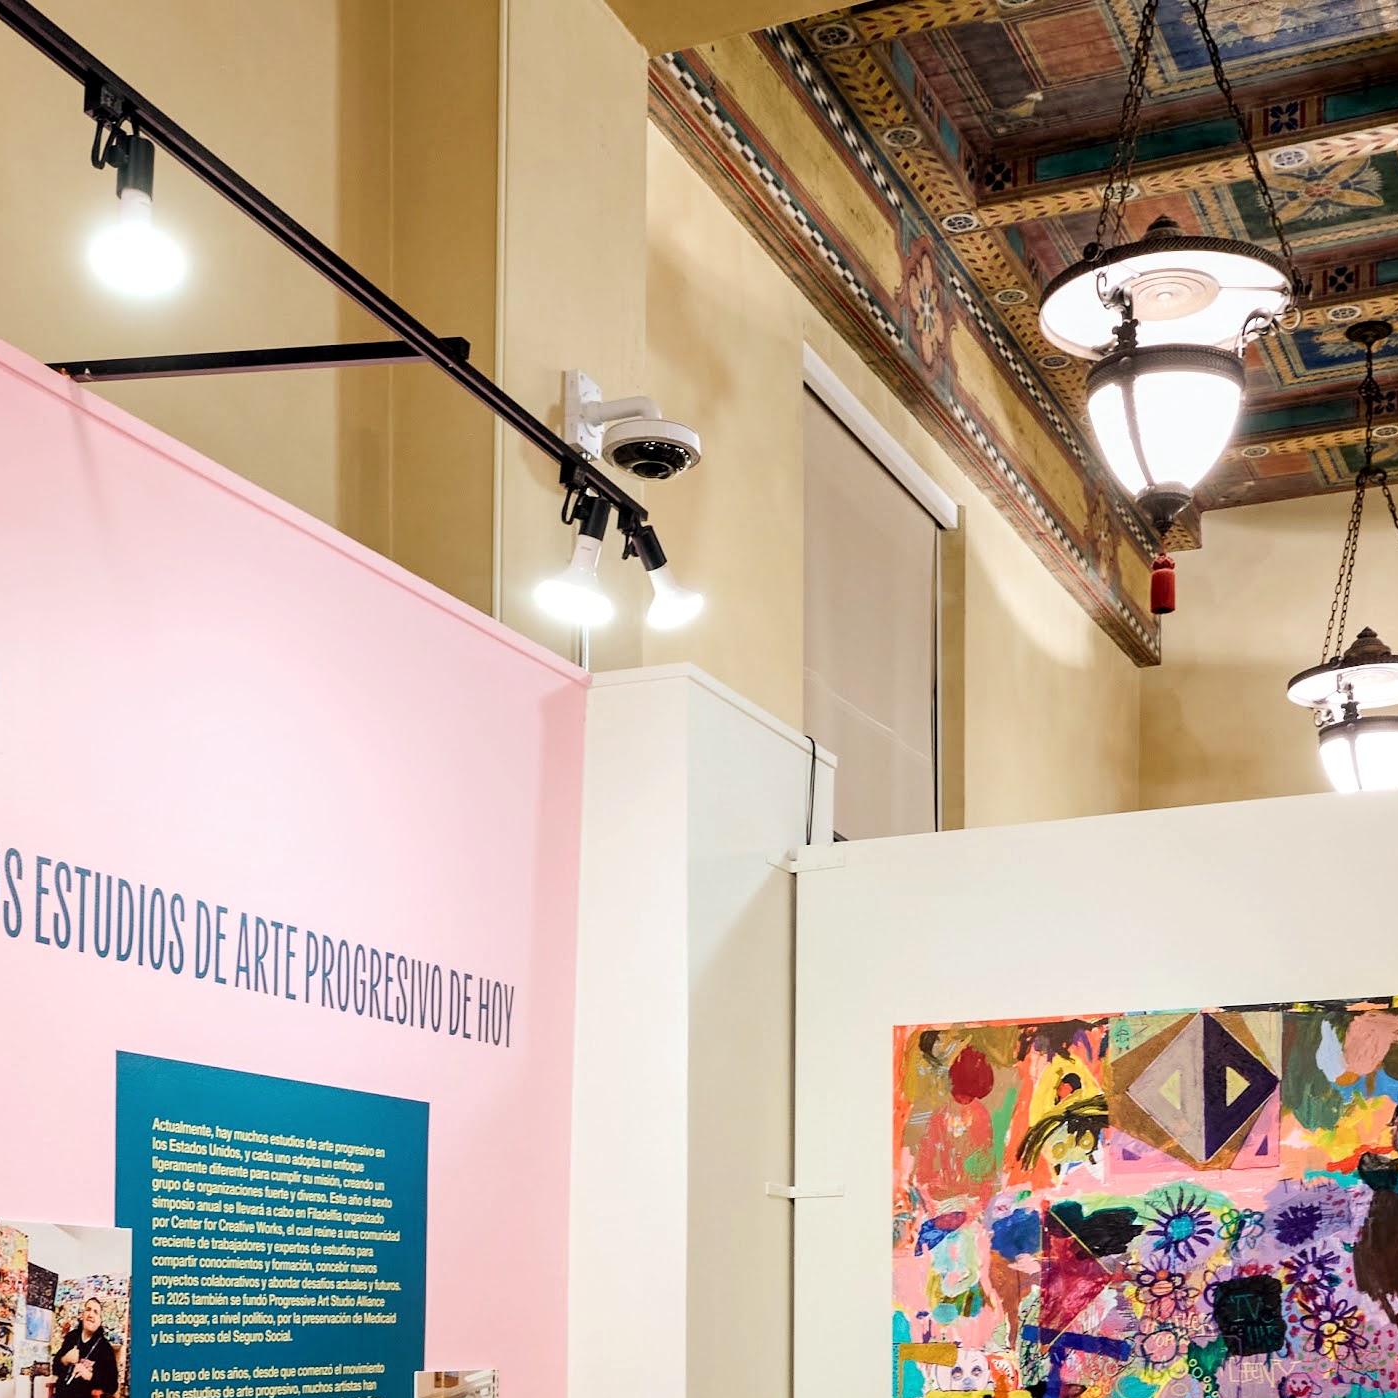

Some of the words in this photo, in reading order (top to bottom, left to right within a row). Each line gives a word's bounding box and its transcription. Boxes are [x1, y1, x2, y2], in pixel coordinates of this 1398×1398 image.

[35, 856, 185, 975] ESTUDIOS
[195, 900, 228, 985] DE
[235, 912, 297, 1000] ARTE
[305, 930, 442, 1033] PROGRESIVO
[448, 969, 472, 1040] DE
[478, 978, 515, 1049] HOY
[151, 1117, 215, 1140] Actualmente,
[215, 1125, 234, 1143] hay
[233, 1129, 270, 1145] muchos
[268, 1134, 306, 1149] estudios
[305, 1137, 318, 1150] de
[316, 1140, 335, 1152] arte
[334, 1143, 376, 1158] progresivo
[374, 1148, 386, 1159] en
[151, 1136, 168, 1151] los
[169, 1138, 208, 1156] Estados
[208, 1143, 244, 1162] Unidos,
[244, 1150, 252, 1163] y
[251, 1150, 274, 1163] cada
[274, 1154, 292, 1165] uno
[291, 1154, 321, 1169] adopta
[321, 1159, 333, 1169] un
[332, 1159, 365, 1174] enfoque
[150, 1369, 160, 1383] A
[160, 1368, 172, 1383] lo
[171, 1368, 198, 1385] largo
[197, 1367, 211, 1381] de
[211, 1367, 227, 1381] los
[226, 1366, 252, 1381] años,
[252, 1365, 280, 1379] desde
[279, 1367, 297, 1380] que
[296, 1363, 334, 1377] comenzó
[333, 1363, 343, 1376] el
[342, 1362, 386, 1375] movimiento
